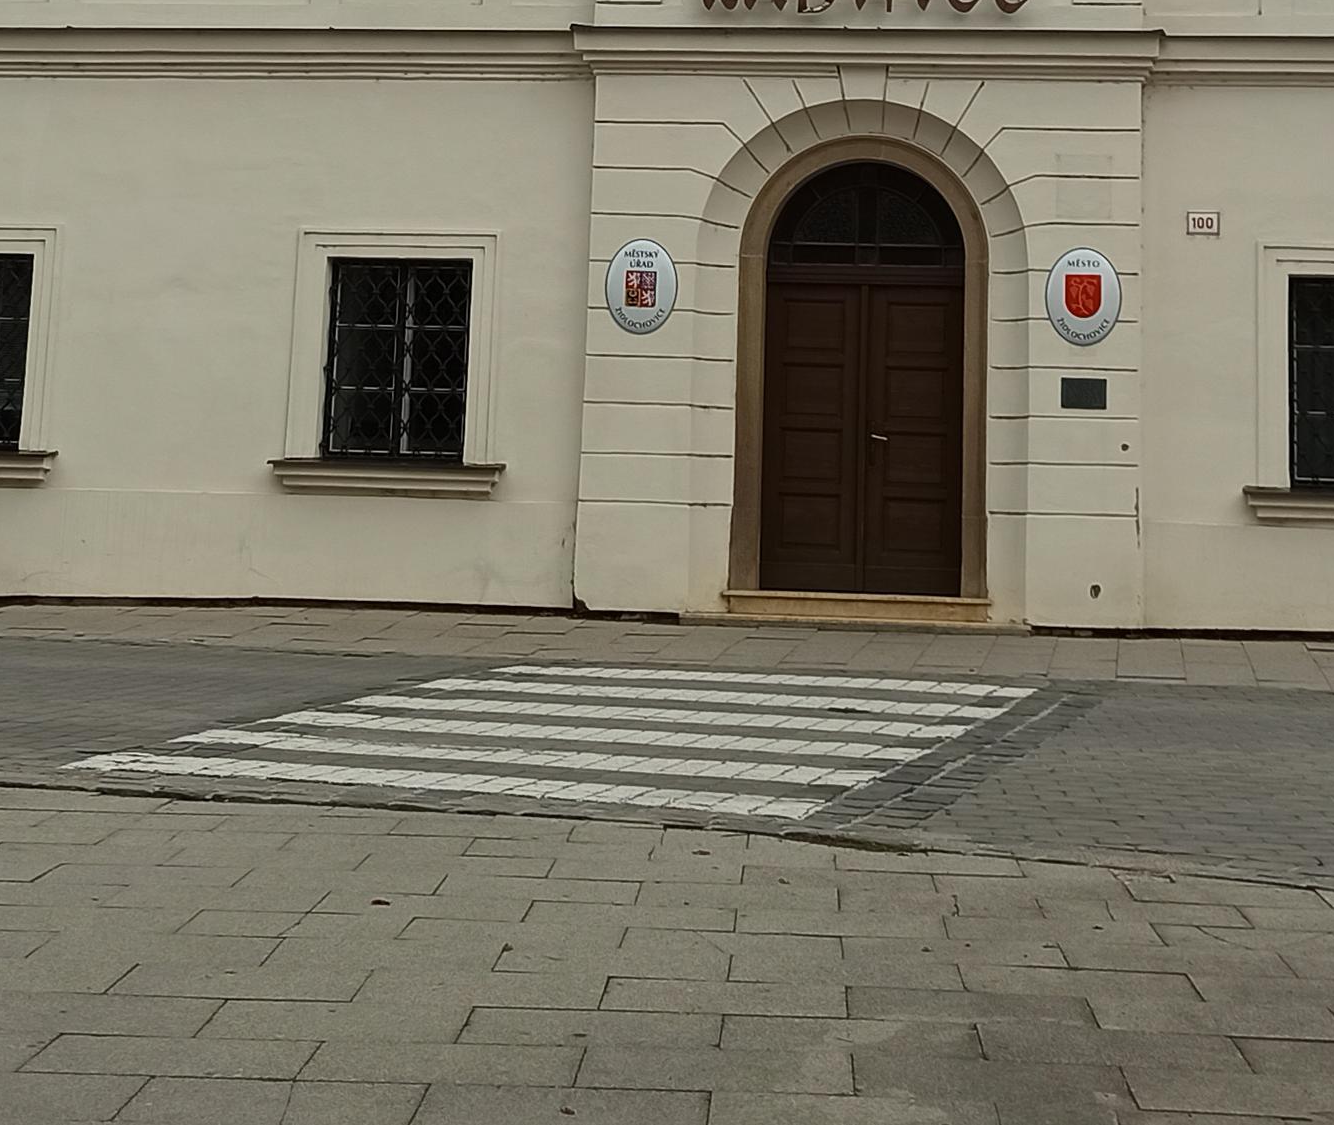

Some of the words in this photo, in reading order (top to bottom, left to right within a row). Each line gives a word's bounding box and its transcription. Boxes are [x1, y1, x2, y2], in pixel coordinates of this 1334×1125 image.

[1192, 217, 1214, 229] 100
[624, 249, 660, 258] MĚSTSKÝ
[629, 259, 654, 268] ÚŘAD
[1067, 258, 1101, 268] MĚSTO
[1056, 317, 1110, 340] ŽIDLOCHOVICE
